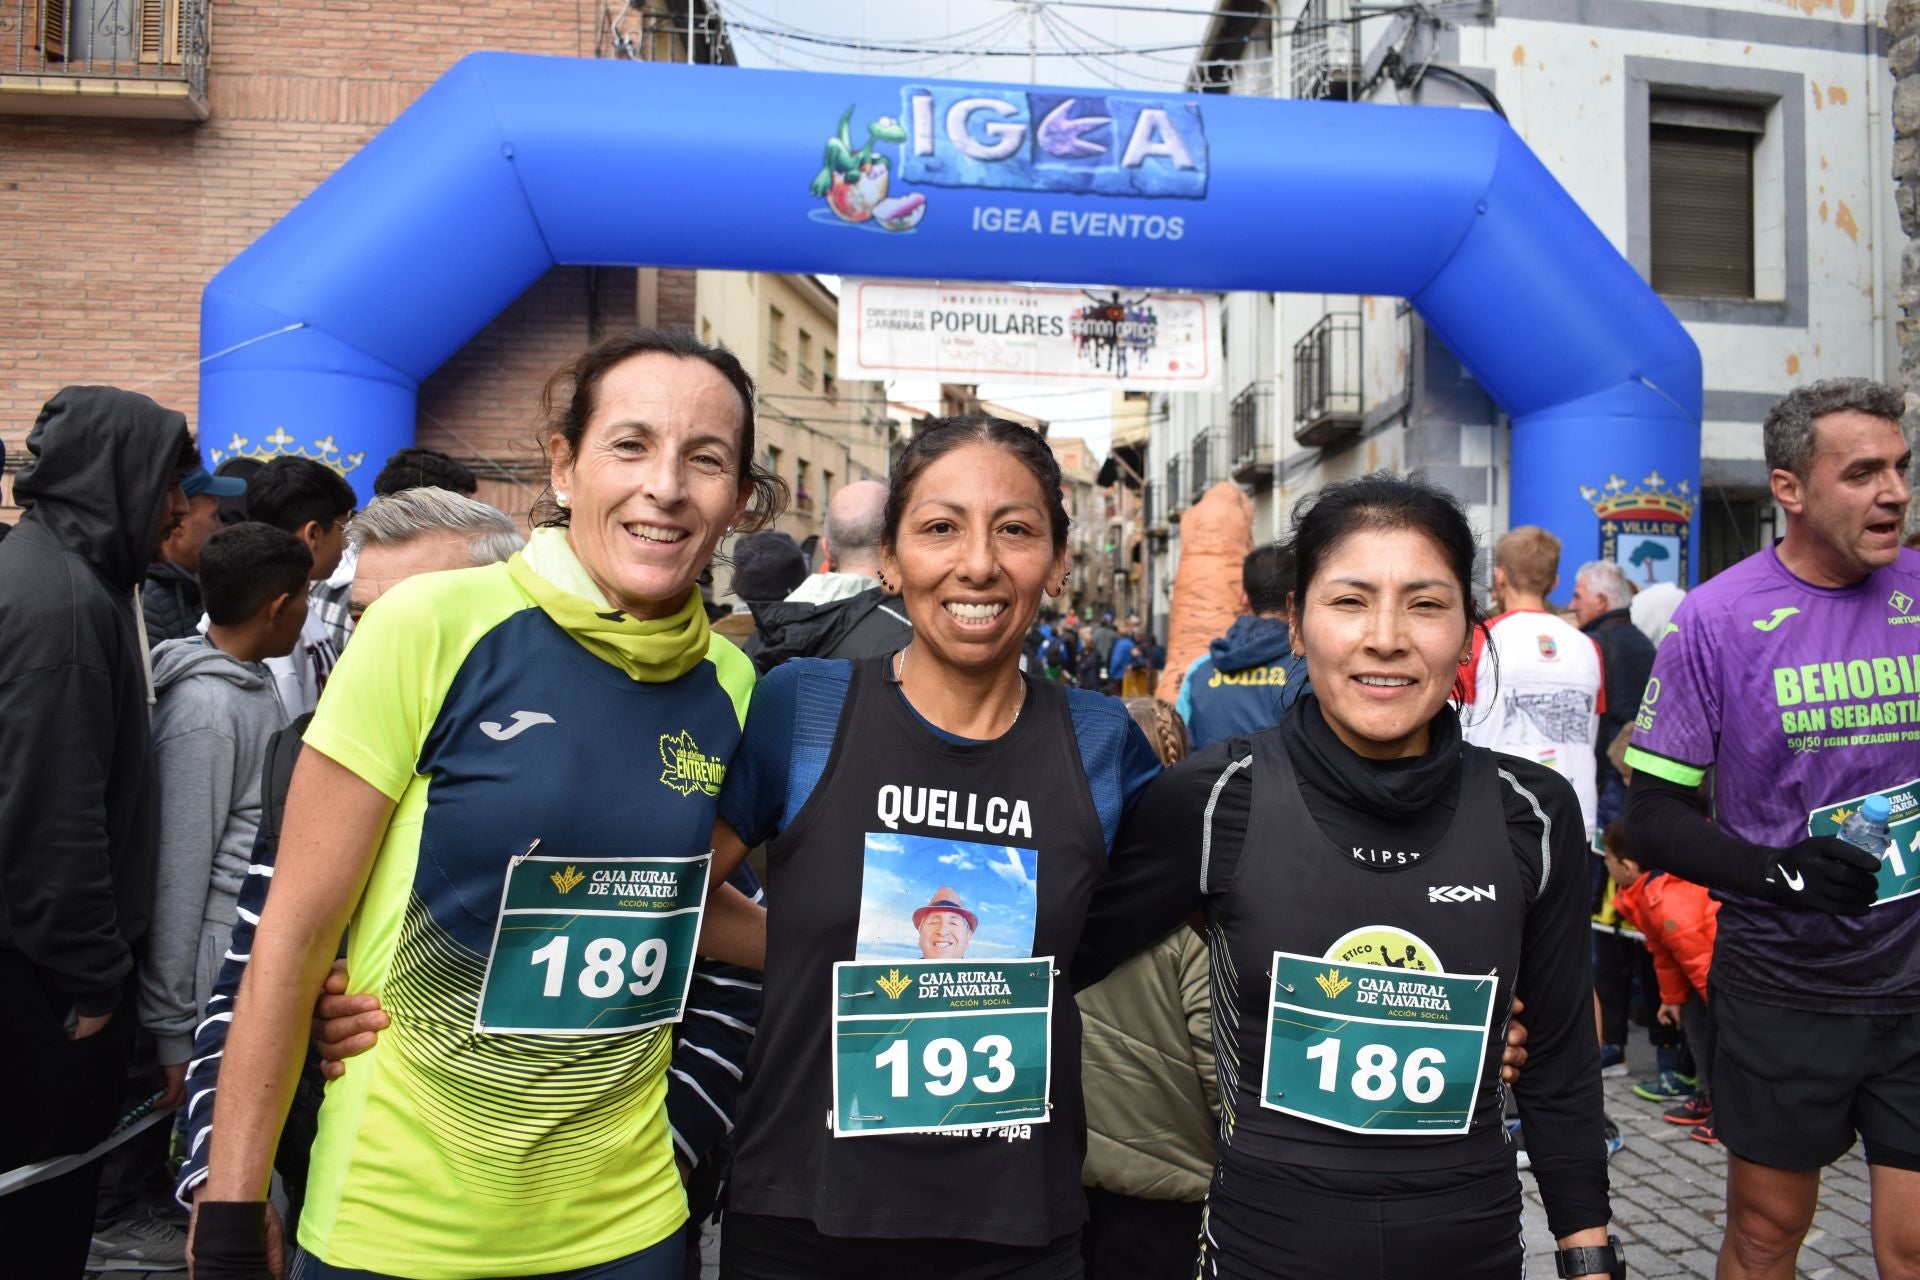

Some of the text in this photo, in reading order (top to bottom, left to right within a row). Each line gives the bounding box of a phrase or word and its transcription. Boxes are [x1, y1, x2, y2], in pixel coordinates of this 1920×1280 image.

[972, 207, 1185, 240] IGEA EVENTOS
[930, 311, 1064, 337] POPULARES
[1622, 521, 1677, 535] VILLA DE
[1781, 699, 1920, 734] SAN SEBASTI
[1888, 791, 1914, 805] URAL
[877, 784, 1033, 839] QUELLCA
[592, 870, 678, 884] CAJA RURAL
[587, 883, 678, 898] DE NAVARRA
[1427, 884, 1497, 903] KON
[618, 899, 649, 907] ACCIÓN
[1342, 944, 1373, 962] ETICO
[531, 936, 668, 998] 189
[919, 971, 1006, 985] CAJA RURAL
[918, 983, 1012, 998] DE NAVARRA
[1358, 977, 1447, 998] CAJA RURAL
[950, 998, 1012, 1007] ACCIÓN SOCIAL
[1356, 990, 1452, 1011] DE NAVARRA
[1387, 1009, 1449, 1021] ACCIÓN SOCIAL
[875, 1034, 1016, 1098] 193
[1306, 1037, 1447, 1104] 186
